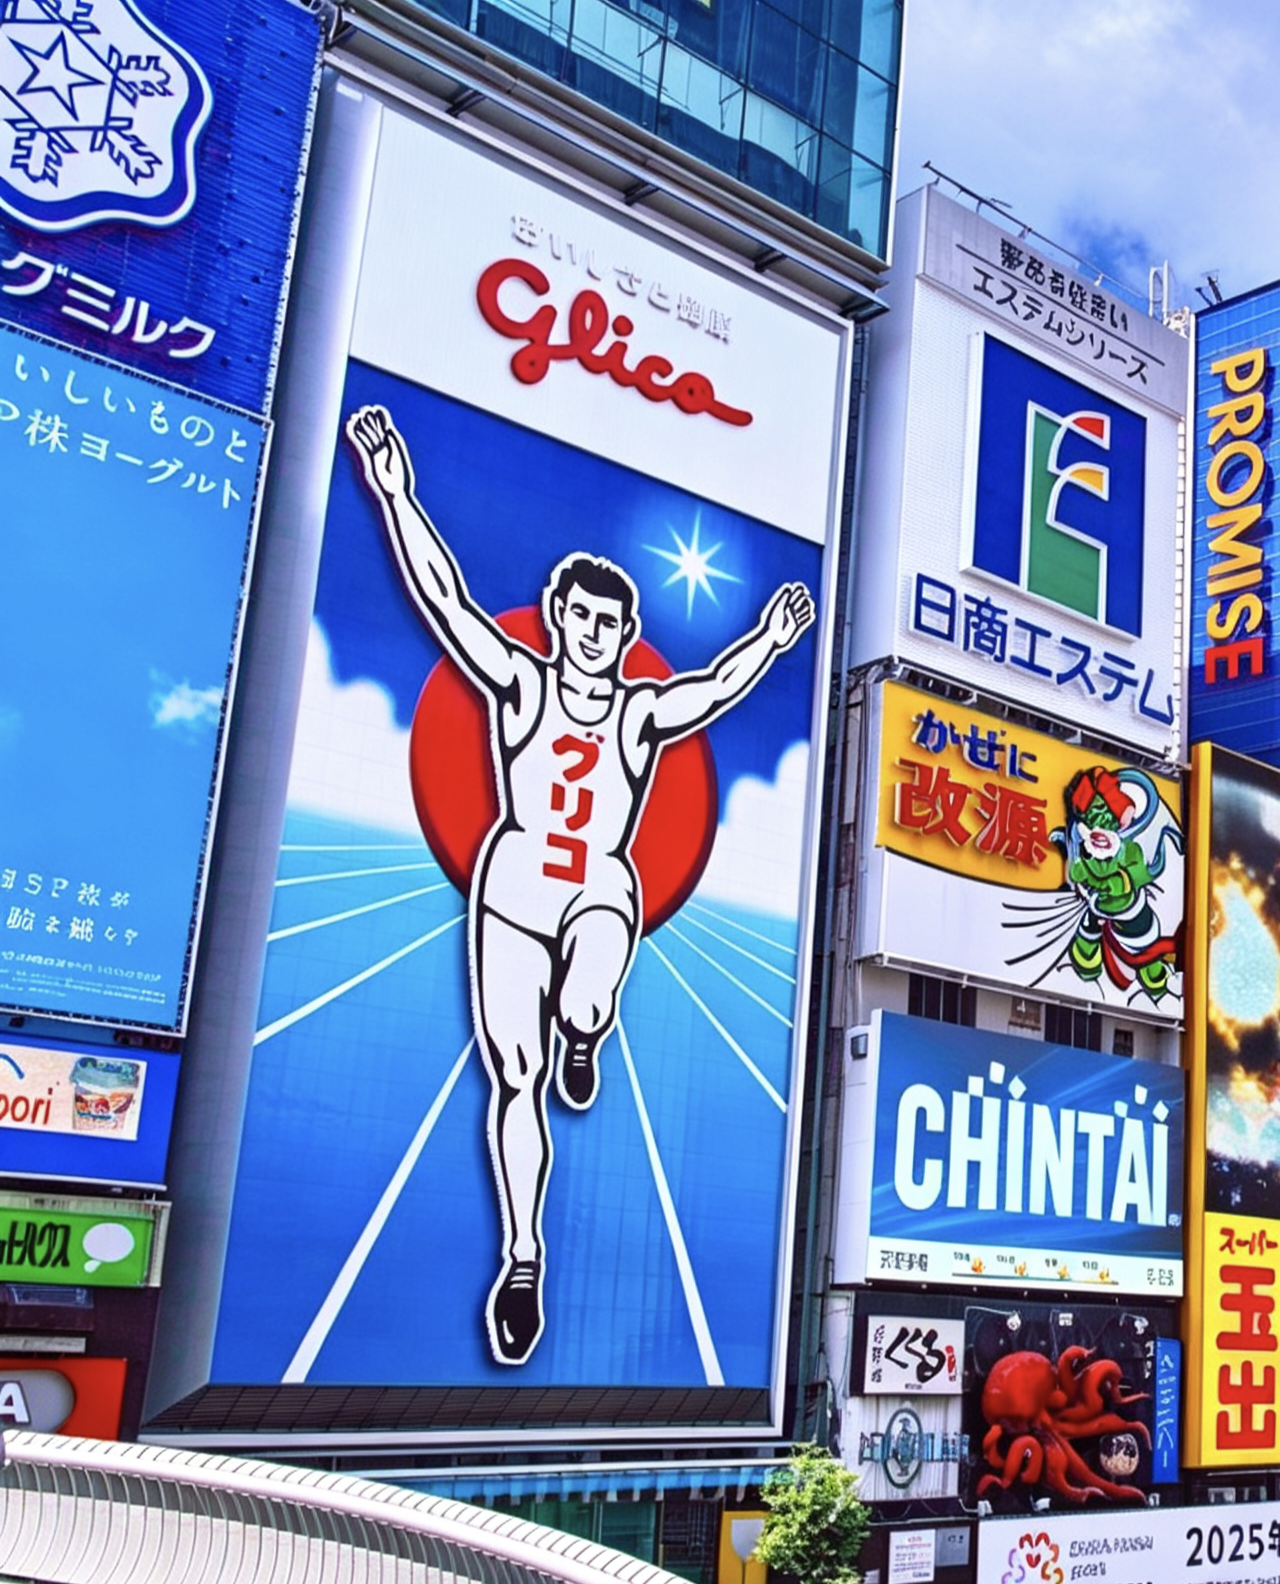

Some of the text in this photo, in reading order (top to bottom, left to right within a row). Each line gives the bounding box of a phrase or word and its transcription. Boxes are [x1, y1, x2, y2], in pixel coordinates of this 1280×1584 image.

[2, 252, 216, 358] グミルク
[476, 258, 753, 427] Glico
[1204, 347, 1265, 684] PROMISE
[914, 572, 1174, 727] 日商エステム
[543, 731, 605, 885] グリコ
[895, 757, 1048, 868] 改源
[912, 708, 1039, 783] かぜに
[894, 1062, 1170, 1228] CHINTAI
[1216, 1264, 1279, 1451] 玉出
